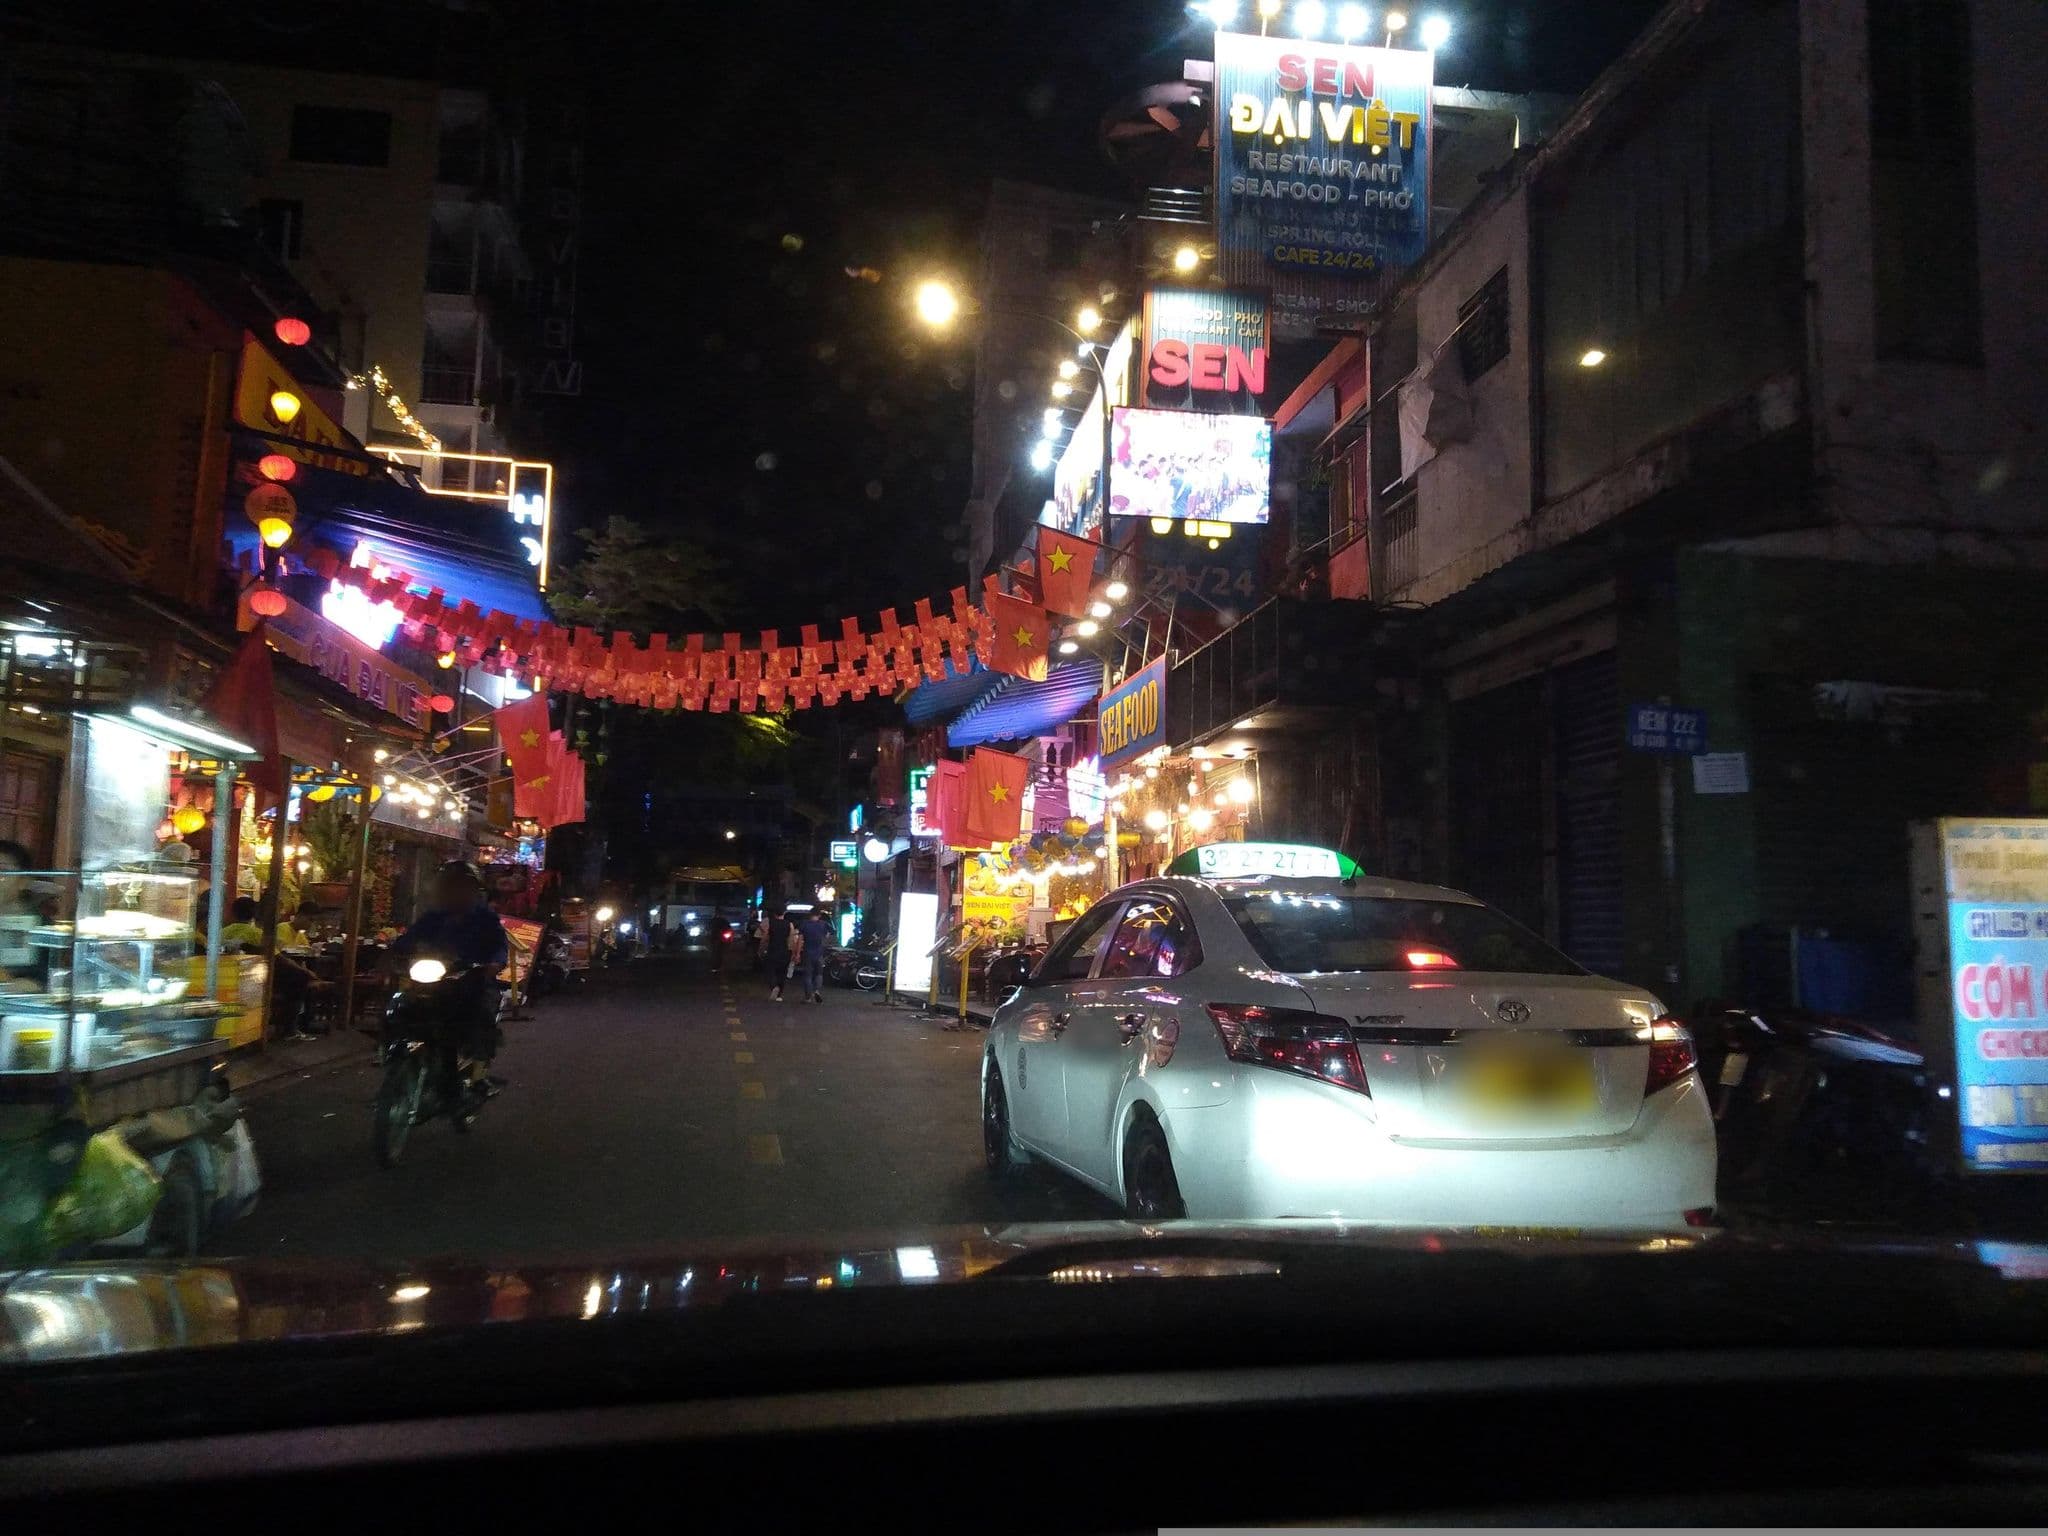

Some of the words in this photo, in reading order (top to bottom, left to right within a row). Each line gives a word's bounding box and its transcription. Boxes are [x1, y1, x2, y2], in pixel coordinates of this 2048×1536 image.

[1277, 53, 1374, 99] SEN
[1230, 93, 1311, 145] ĐẠI
[1318, 98, 1420, 155] VIỆT
[1247, 150, 1402, 184] RESTAURANT
[1230, 176, 1342, 203] SEAFOOD
[1273, 245, 1320, 266] CAFE
[1322, 249, 1376, 270] 24/24
[1151, 338, 1266, 395] SEN
[1100, 679, 1159, 757] SEAFOOD
[1272, 850, 1298, 869] 27
